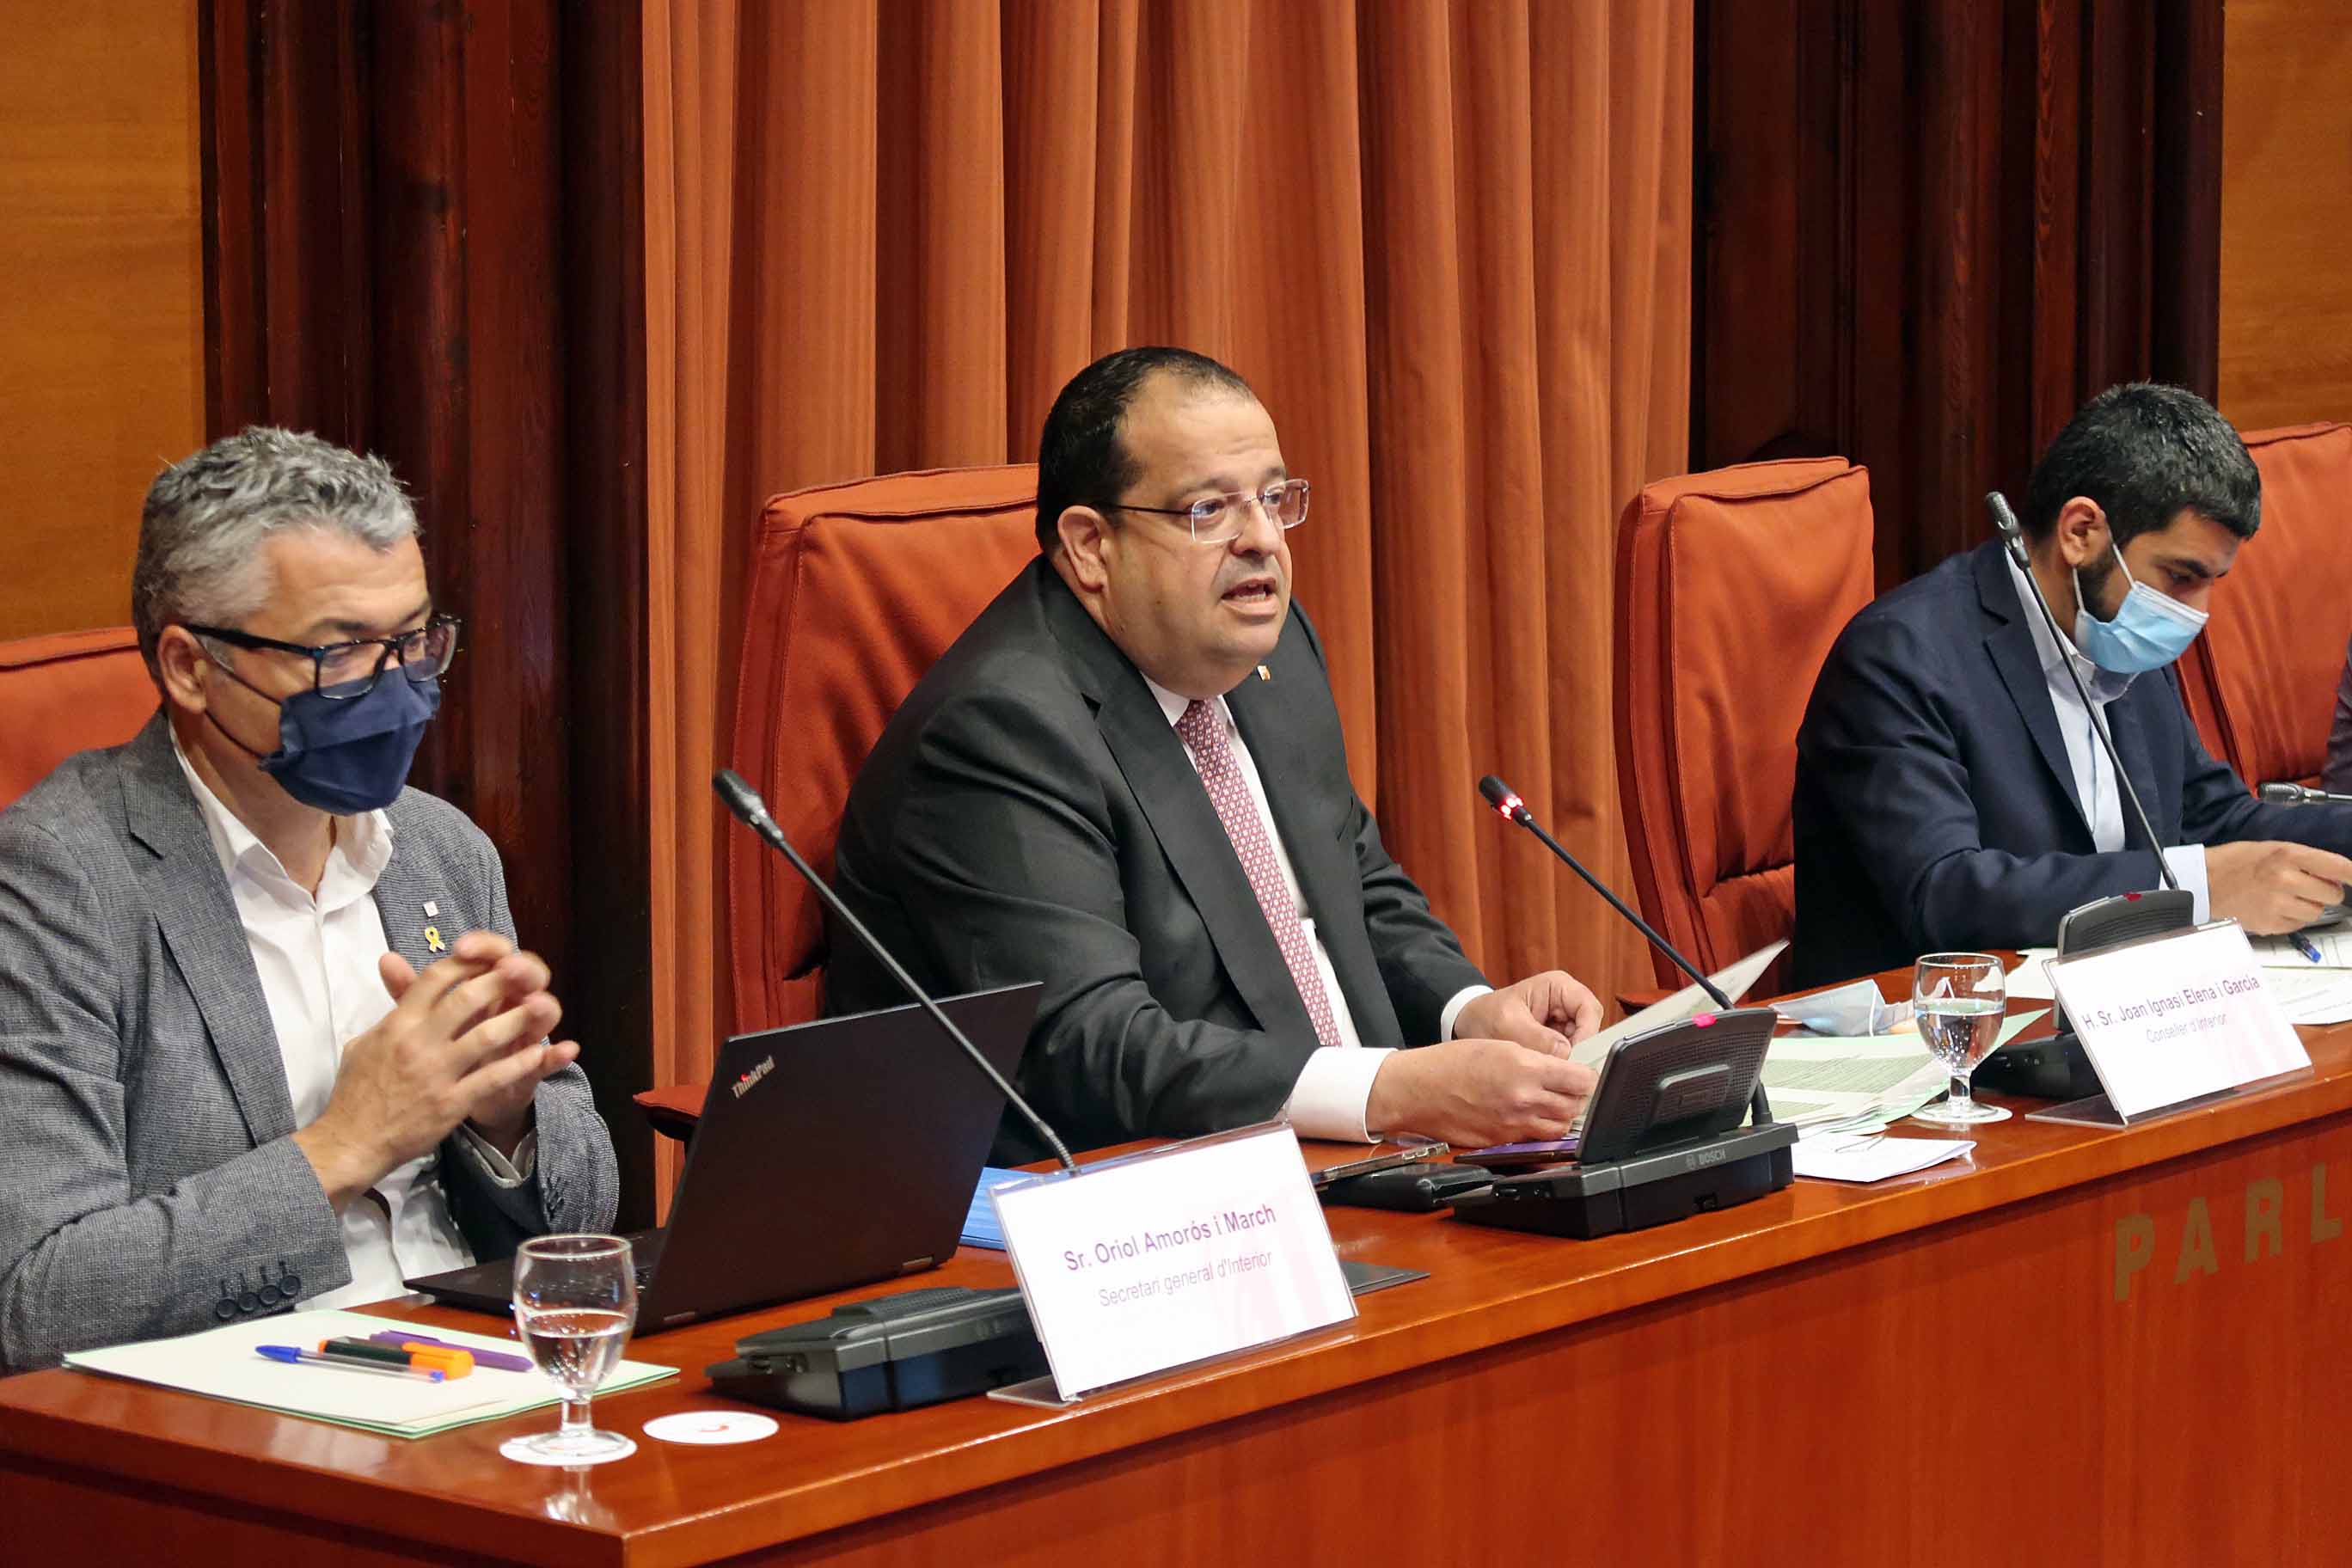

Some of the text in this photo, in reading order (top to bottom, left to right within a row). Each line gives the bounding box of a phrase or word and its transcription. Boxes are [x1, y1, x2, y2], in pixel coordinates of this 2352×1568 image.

[2080, 1014, 2098, 1031] H.
[2098, 1009, 2118, 1026] Sr.
[2118, 1001, 2148, 1022] Joan
[2147, 992, 2185, 1017] Ignasi
[2182, 987, 2217, 1005] Elena
[2214, 983, 2224, 997] i
[731, 1054, 775, 1099] ThinkPad
[1698, 1148, 1726, 1166] BOSCH
[1063, 1204, 1277, 1271] Sr. Oriol Amorós i March
[1099, 1250, 1273, 1307] Secretari general d'Interior
